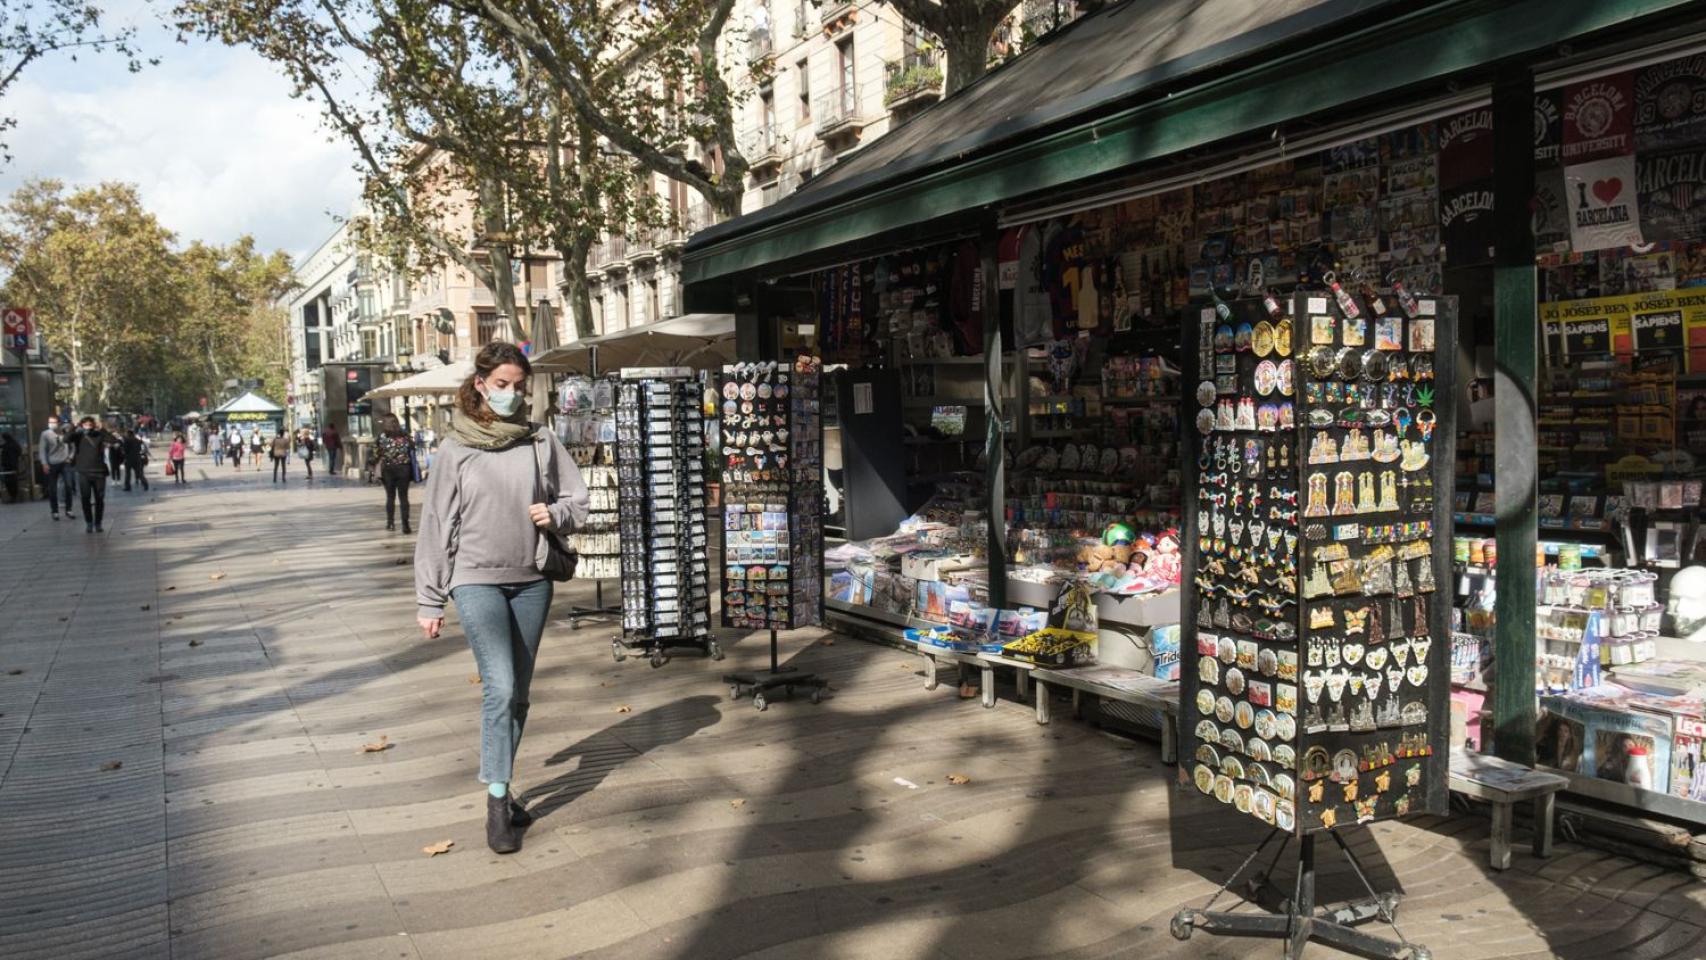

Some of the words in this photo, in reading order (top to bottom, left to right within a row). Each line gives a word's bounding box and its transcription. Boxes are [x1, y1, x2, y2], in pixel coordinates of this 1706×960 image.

[1564, 83, 1627, 120] BARCELONA
[1562, 134, 1627, 157] UNIVERSITY
[1577, 183, 1588, 208] I
[1576, 204, 1630, 228] BARCELONA
[1562, 306, 1601, 318] JOSEP
[1633, 298, 1674, 312] JOSEP
